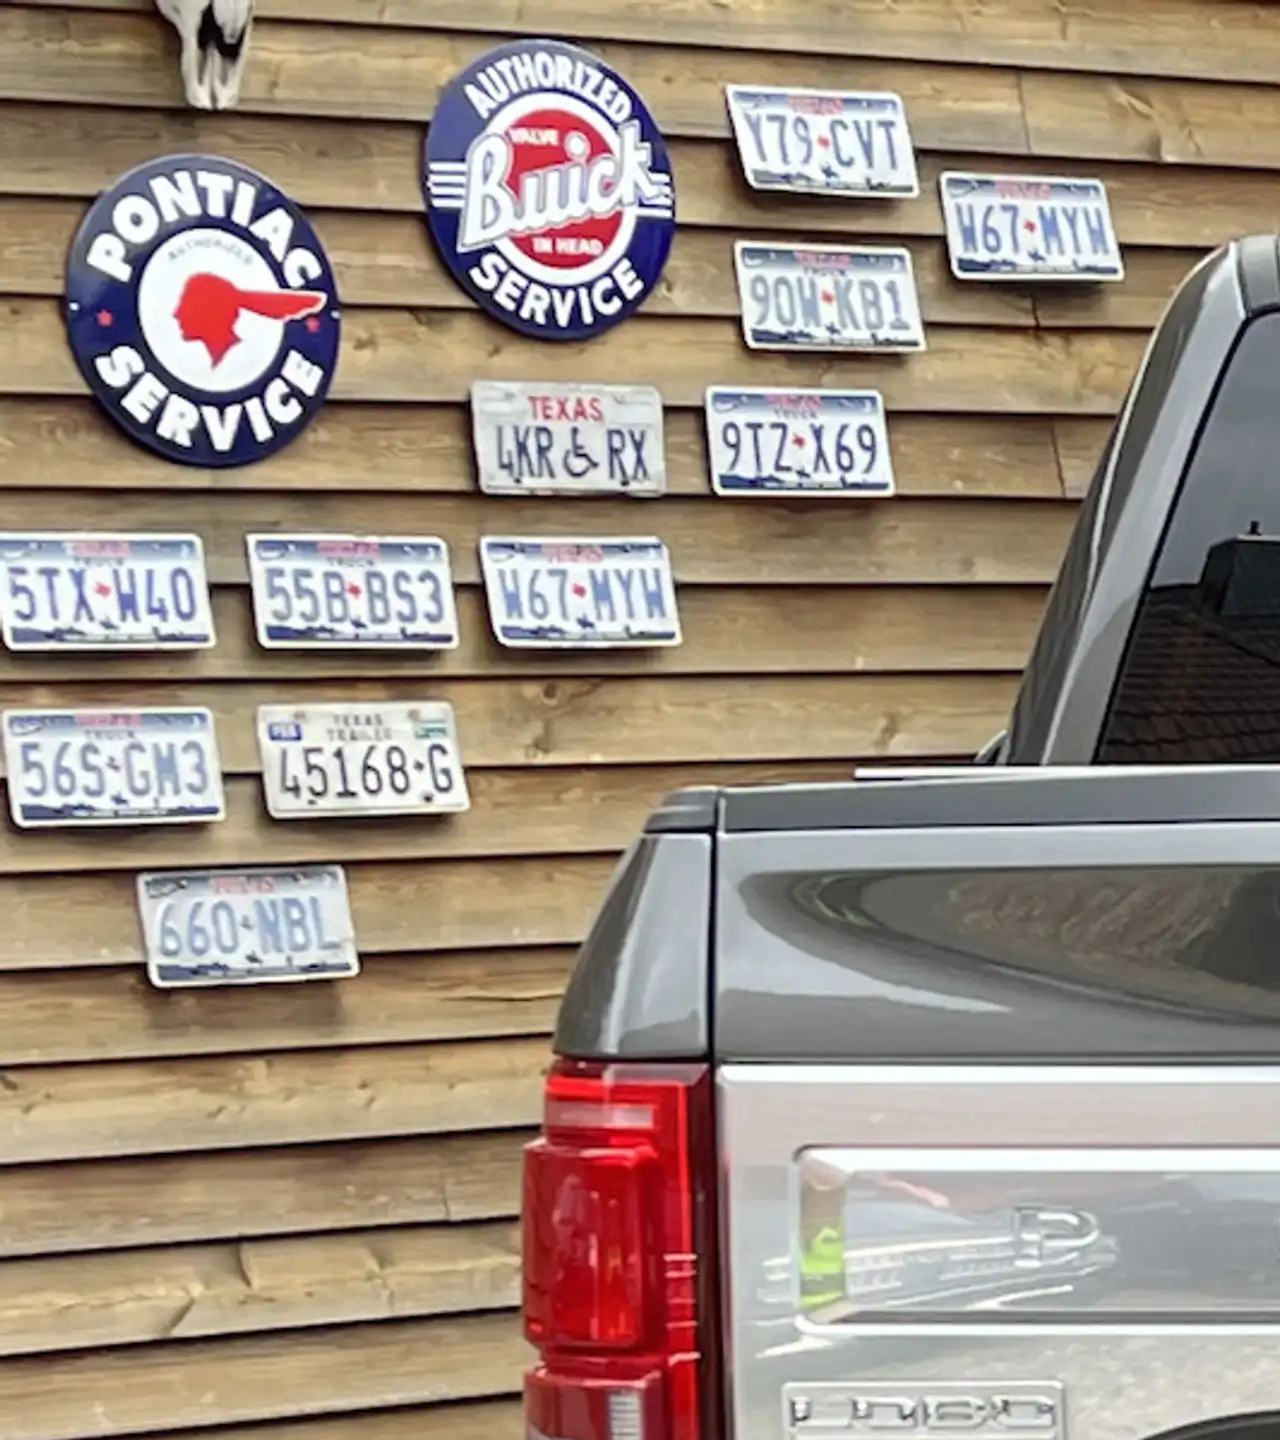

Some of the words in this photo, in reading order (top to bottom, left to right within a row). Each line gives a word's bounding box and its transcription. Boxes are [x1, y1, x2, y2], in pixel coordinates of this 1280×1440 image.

[464, 52, 632, 124] AUTHORIZED
[829, 119, 898, 171] CVT
[457, 119, 665, 253] Buick
[86, 169, 323, 289] PONTIAC
[468, 252, 645, 328] SERVICE
[834, 278, 911, 331] KB1
[94, 345, 325, 452] SERVICE
[528, 395, 605, 422] TEXAS
[496, 425, 556, 479] 4KR
[606, 428, 651, 481] RX
[722, 421, 793, 473] 9TZ
[809, 423, 877, 474] X69
[8, 566, 96, 622] 5TX
[264, 566, 350, 623] 55B
[365, 569, 445, 625] BS3
[333, 712, 384, 727] TEXAS
[20, 741, 107, 798] 56S
[279, 744, 411, 800] 45168
[427, 743, 454, 794] G
[253, 895, 343, 956] NBL
